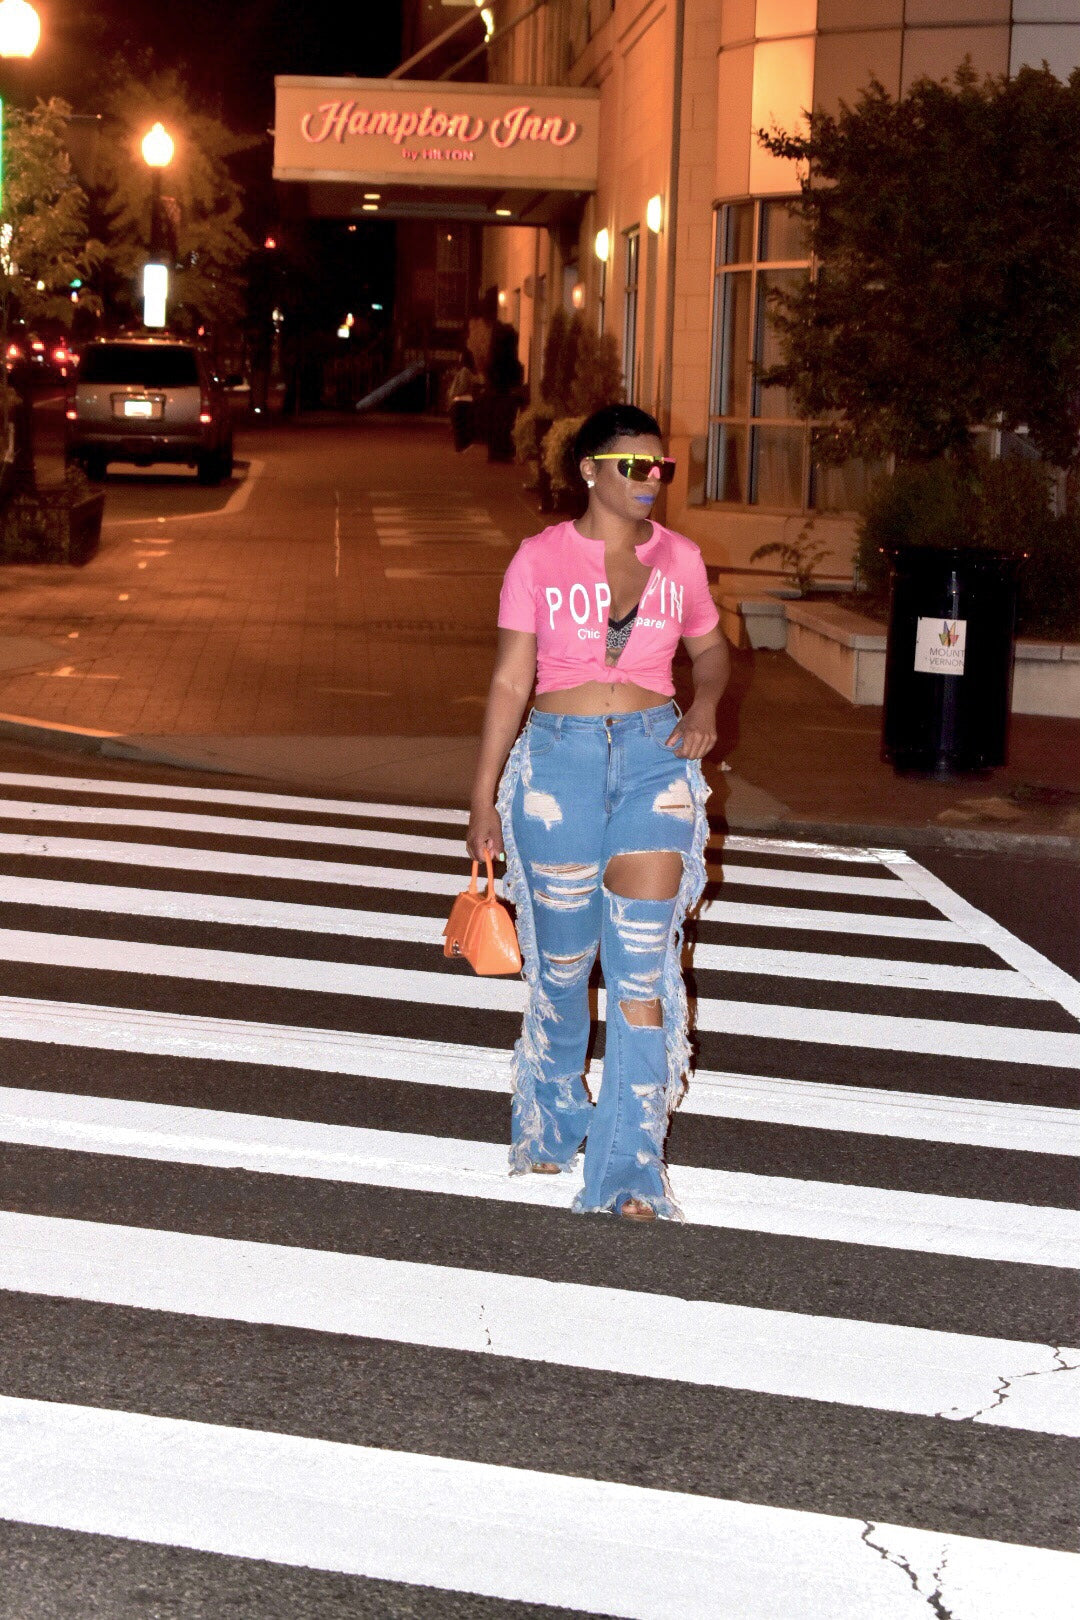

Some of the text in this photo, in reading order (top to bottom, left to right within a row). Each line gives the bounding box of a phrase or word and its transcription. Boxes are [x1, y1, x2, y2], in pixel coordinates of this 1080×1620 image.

[301, 100, 576, 148] Hampton Inn
[402, 148, 474, 161] by HILTON
[929, 647, 965, 657] MOUNT
[929, 657, 964, 667] VERNON
